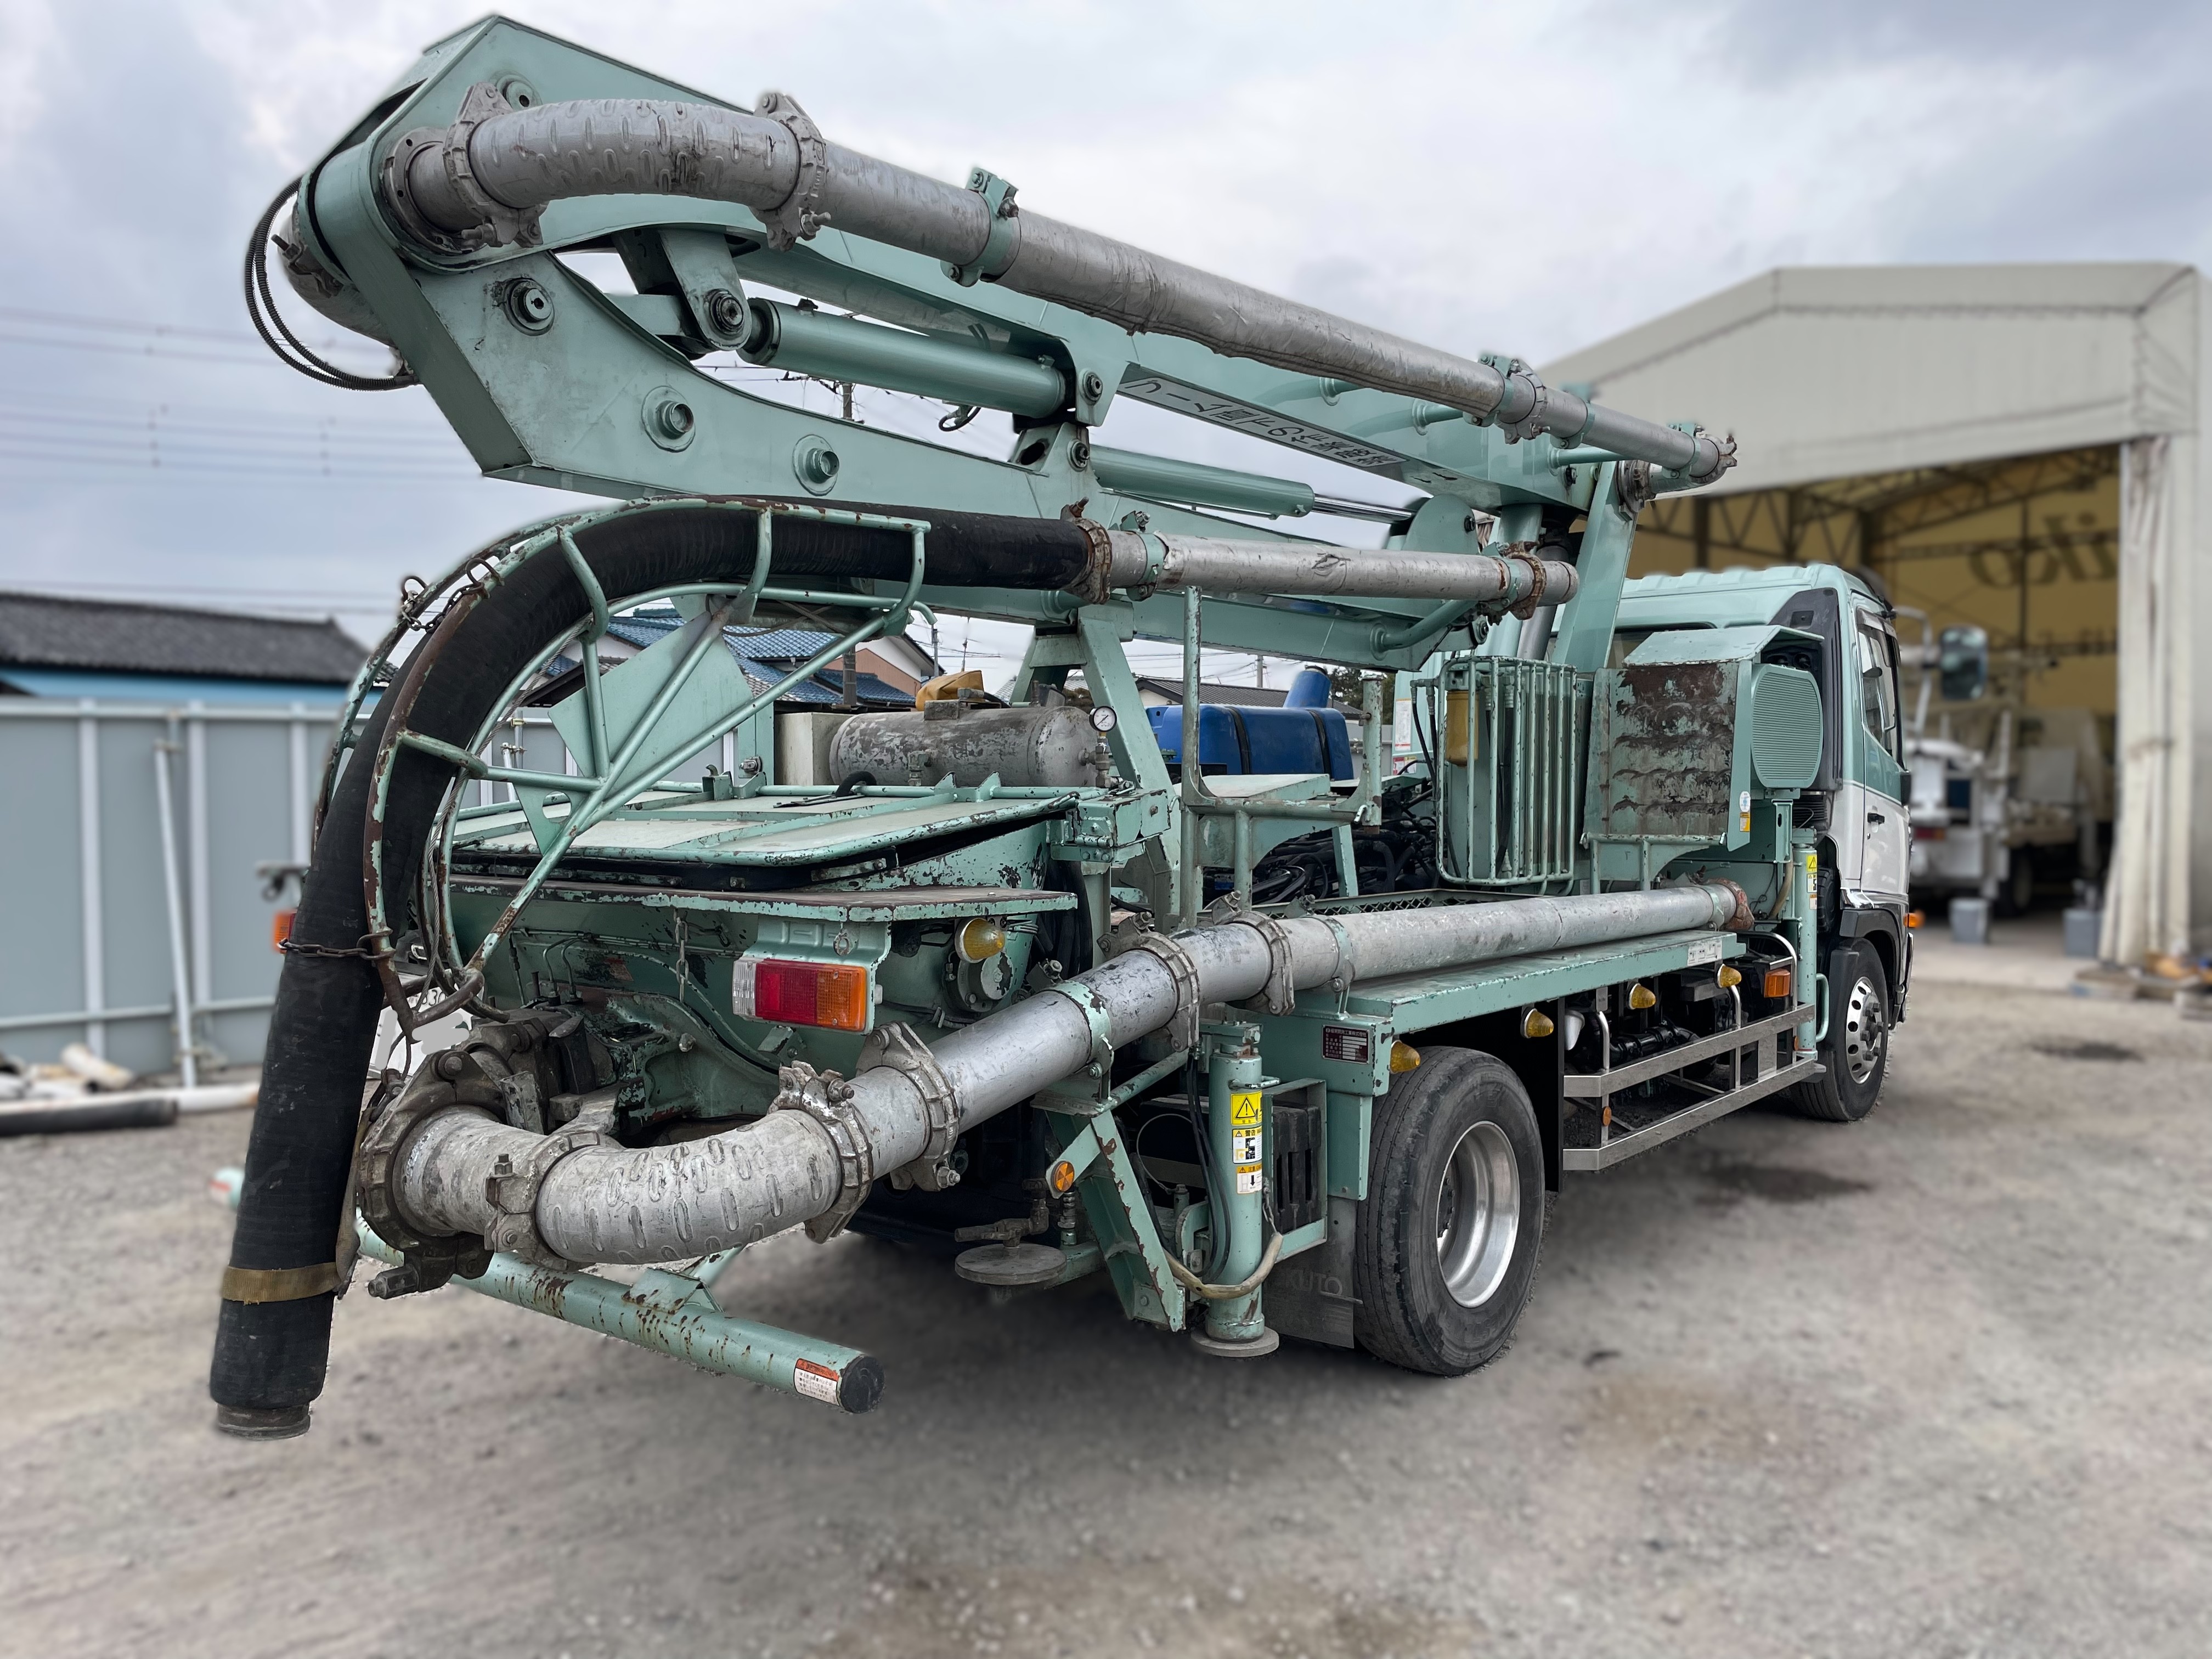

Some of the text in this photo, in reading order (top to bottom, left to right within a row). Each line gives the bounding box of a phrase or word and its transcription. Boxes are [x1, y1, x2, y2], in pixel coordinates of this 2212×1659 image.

[1125, 379, 1398, 465] ブーム直下の作業厳禁
